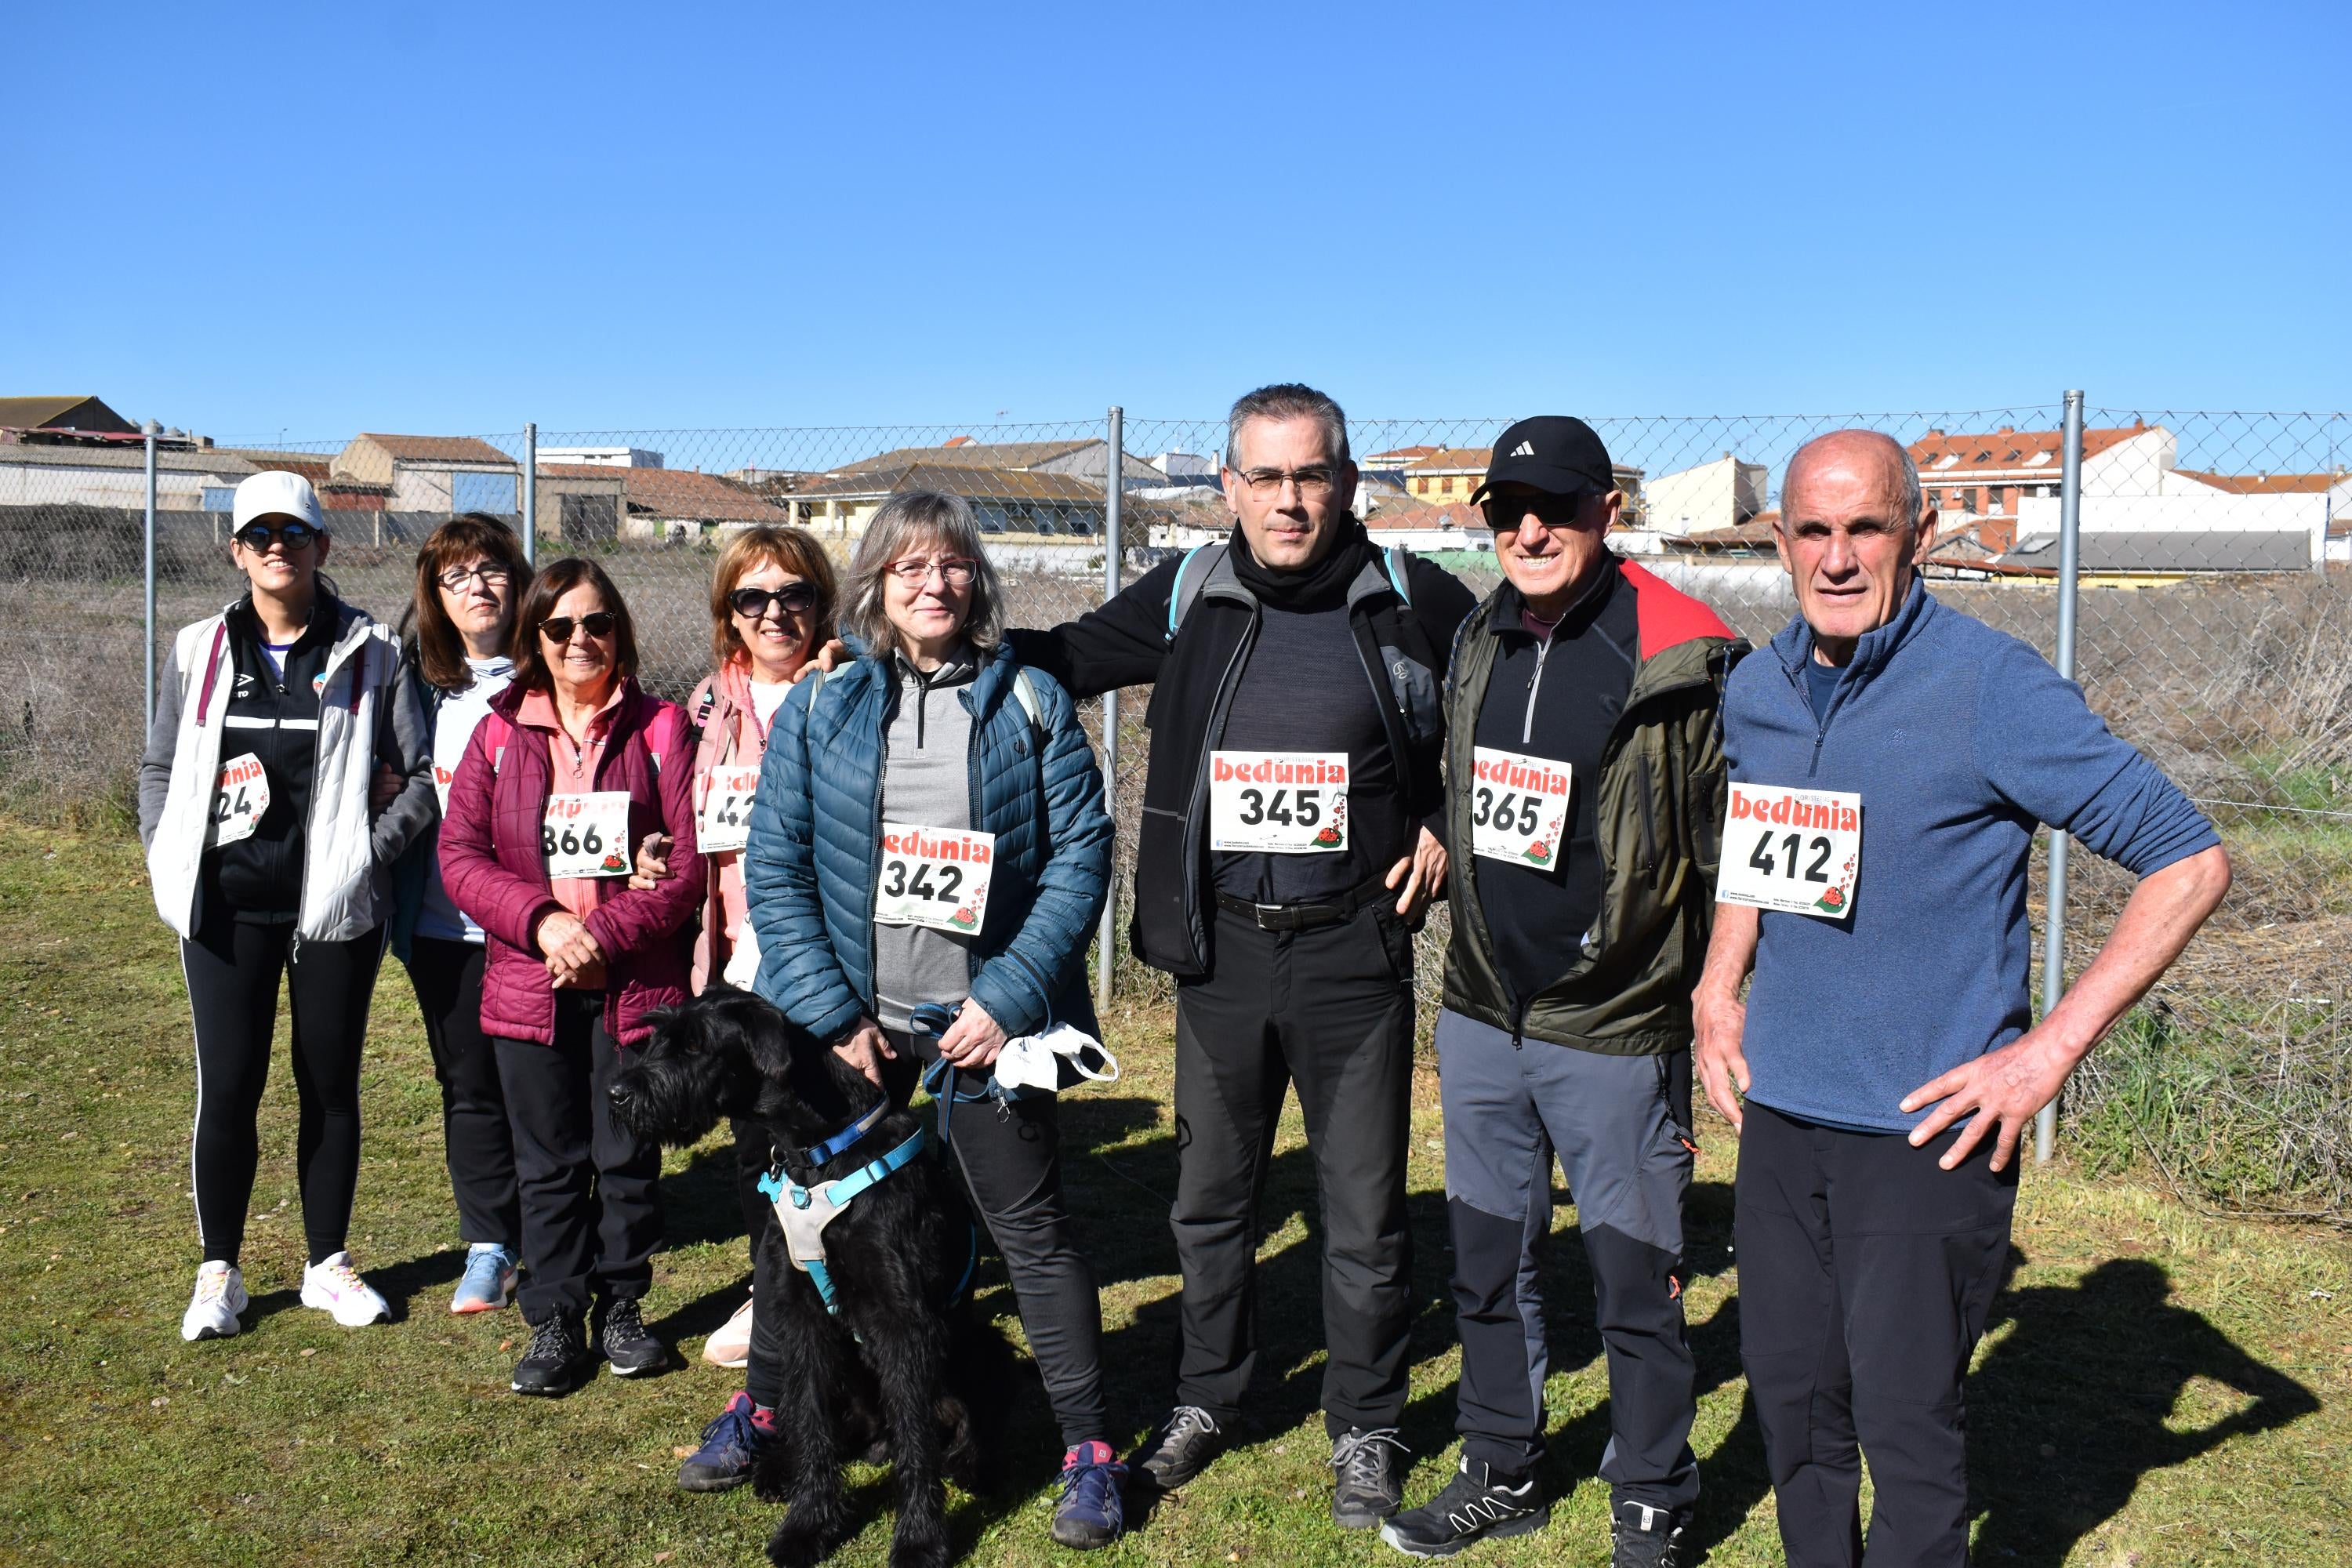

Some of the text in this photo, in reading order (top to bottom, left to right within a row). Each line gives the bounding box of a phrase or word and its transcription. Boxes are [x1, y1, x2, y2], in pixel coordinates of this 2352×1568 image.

[1215, 758, 1345, 784] bedunia
[1240, 789, 1320, 826] 345
[1473, 787, 1543, 836] 365
[1731, 790, 1857, 832] bedunia
[1749, 830, 1831, 884] 412
[884, 860, 963, 904] 342
